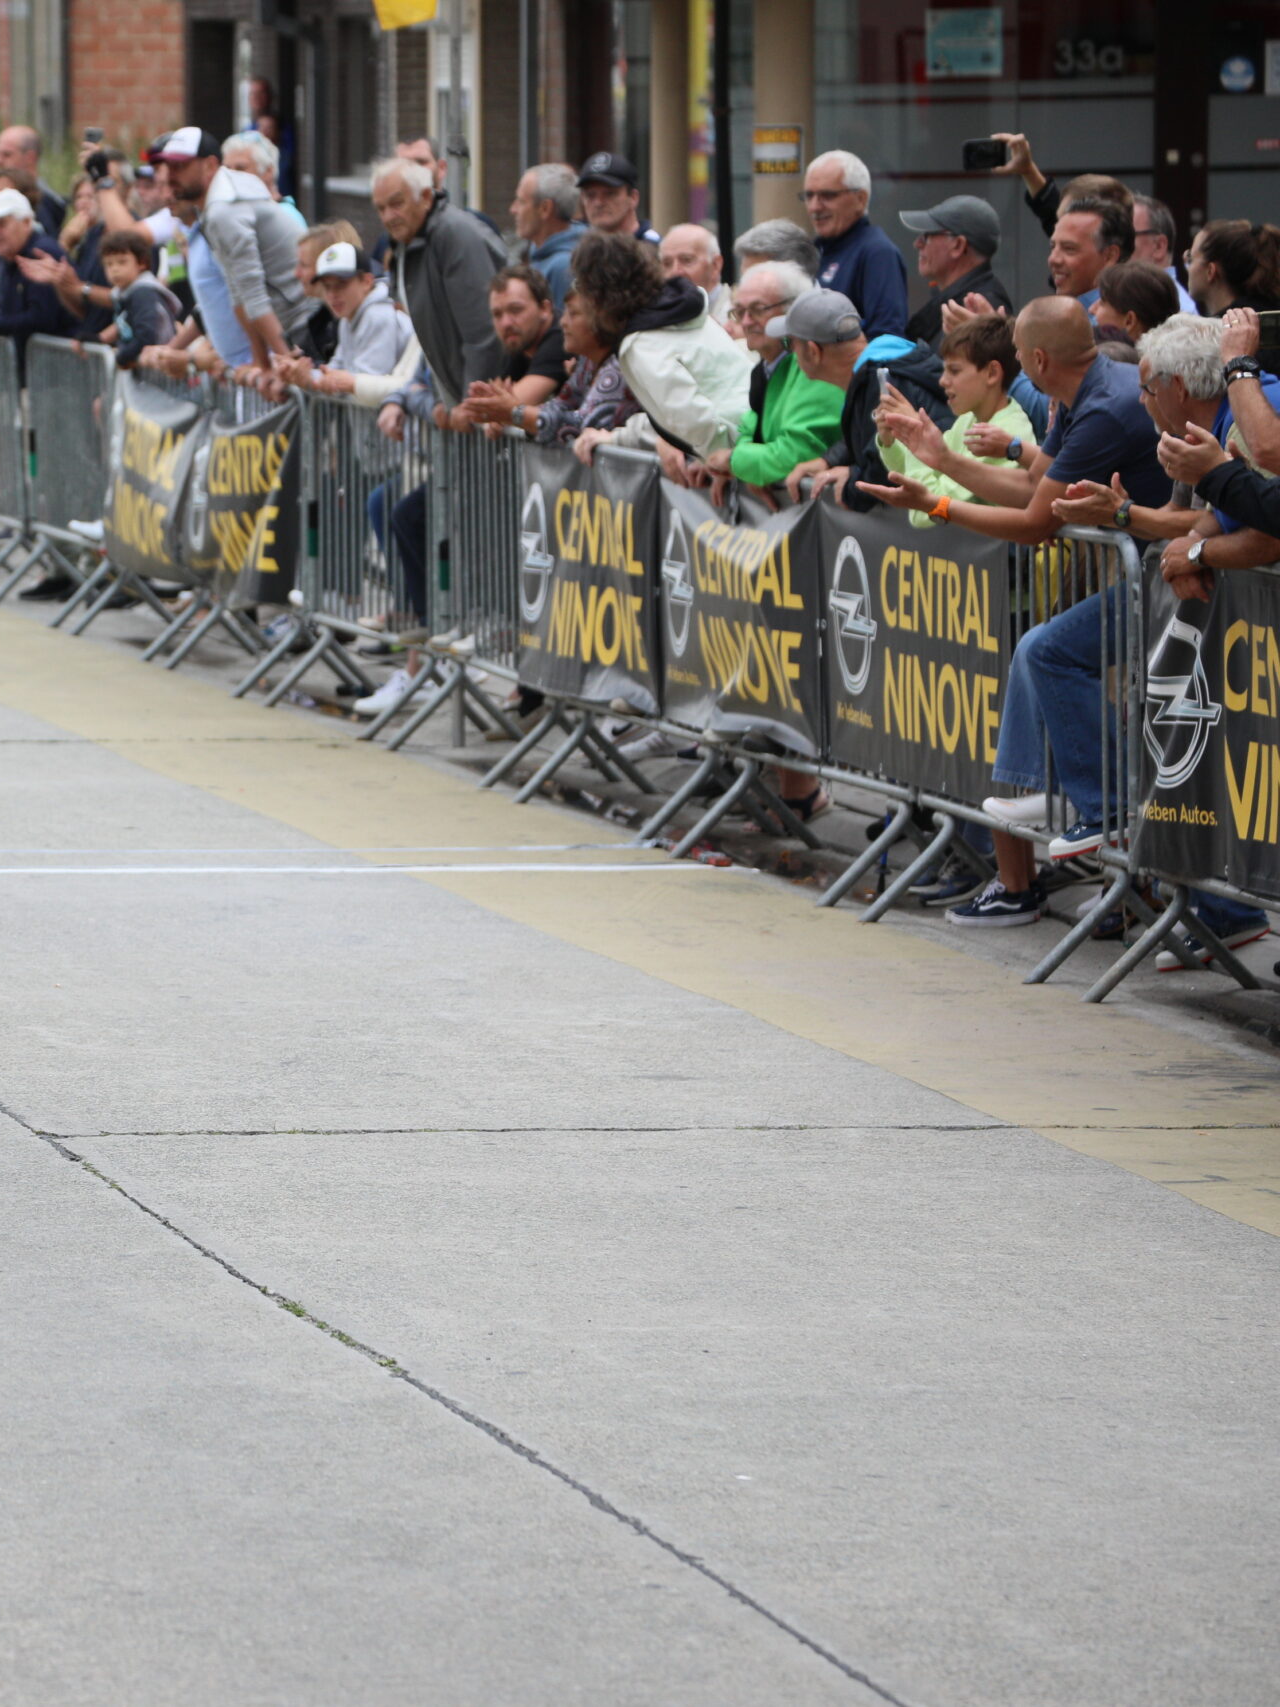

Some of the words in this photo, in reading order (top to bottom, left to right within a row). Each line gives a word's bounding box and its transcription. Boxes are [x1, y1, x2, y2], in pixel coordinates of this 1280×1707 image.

[1055, 40, 1123, 73] 33a
[554, 488, 644, 576] CENTRAL
[693, 519, 804, 610] CENTRAL
[546, 577, 649, 672] NINOVE
[880, 545, 999, 653] CENTRAL
[884, 647, 1000, 764] NINOVE
[1180, 803, 1218, 826] Autos.
